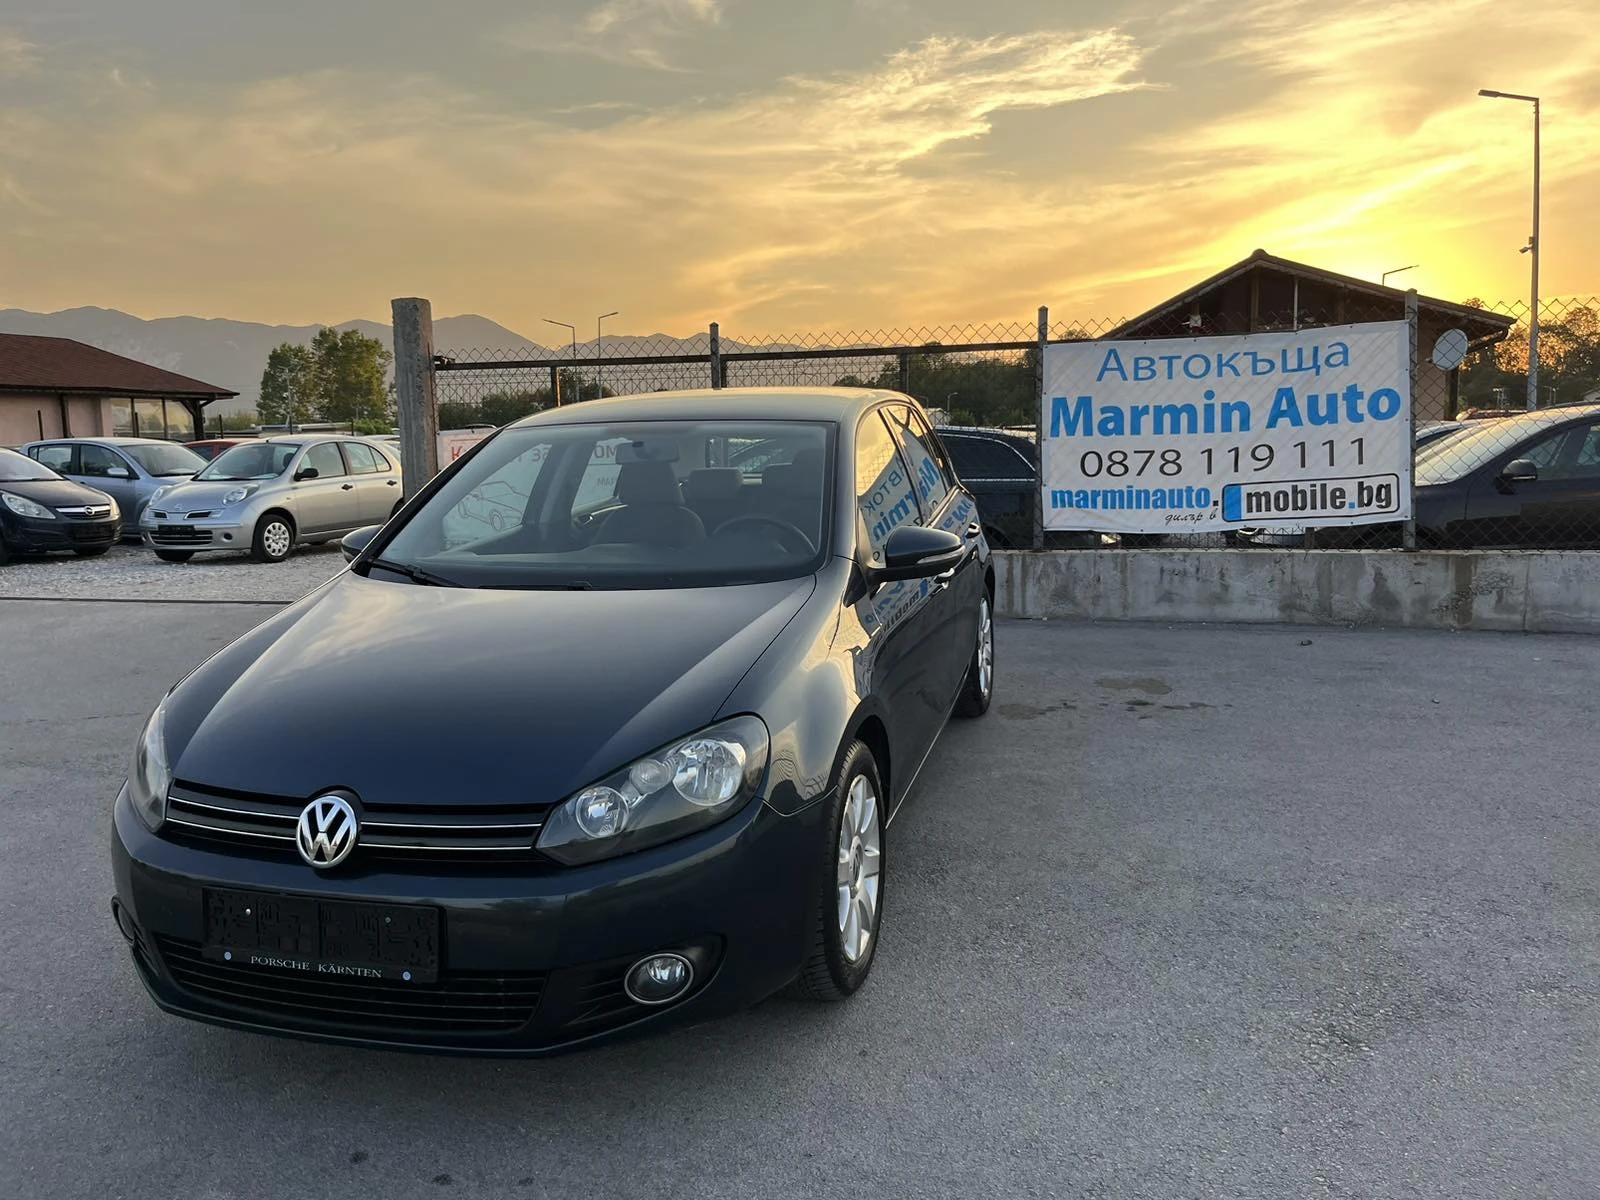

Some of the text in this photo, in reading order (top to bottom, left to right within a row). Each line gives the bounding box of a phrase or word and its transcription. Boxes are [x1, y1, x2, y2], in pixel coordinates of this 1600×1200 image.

[1096, 342, 1349, 382] Автокъща
[1049, 383, 1401, 438] Marmin Auto
[1080, 437, 1365, 477] 0878 119 111
[1246, 481, 1392, 513] mobile.bg
[250, 955, 382, 978] PORSCHE KÄRNTEN
